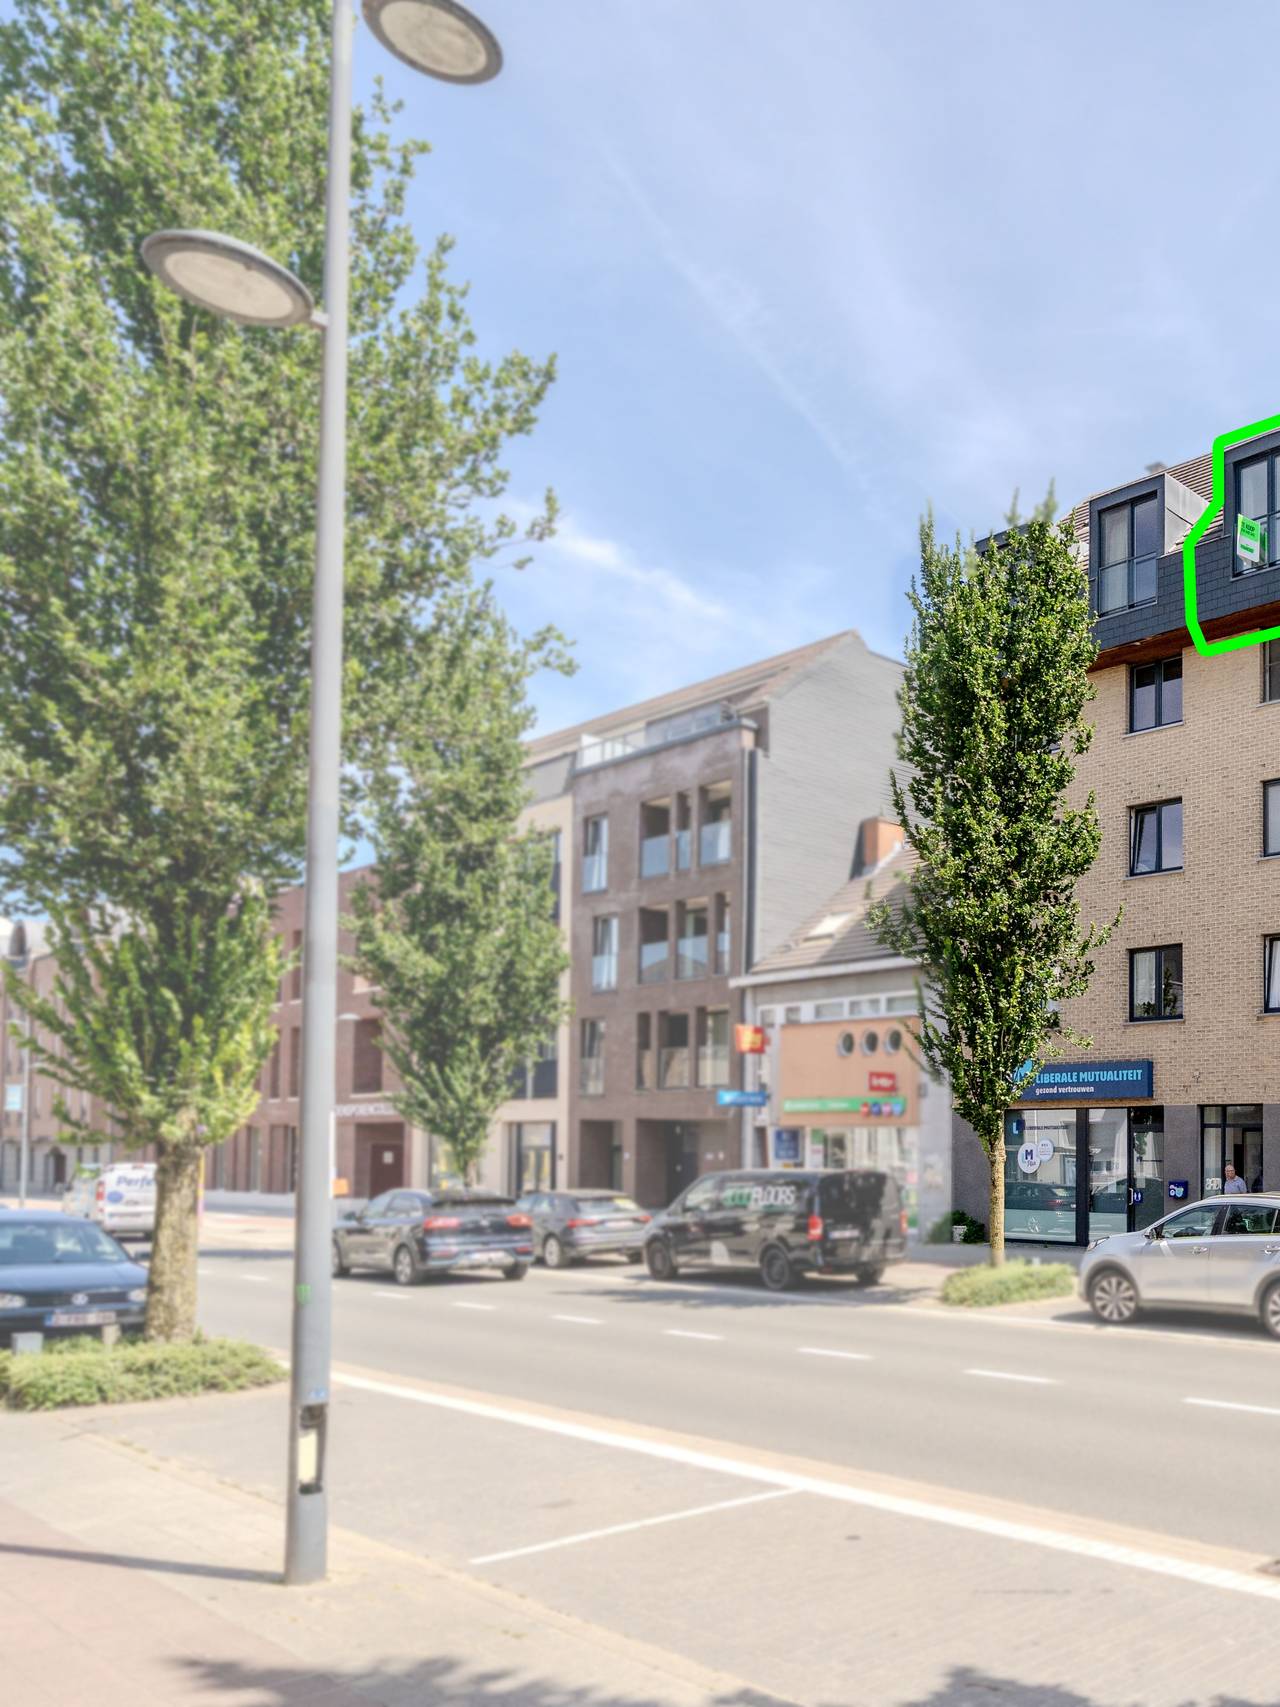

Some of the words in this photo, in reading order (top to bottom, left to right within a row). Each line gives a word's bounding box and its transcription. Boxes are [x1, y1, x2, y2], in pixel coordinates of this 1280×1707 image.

[1036, 1072, 1078, 1083] LIBERALE
[1079, 1069, 1143, 1082] MUTUALITEIT
[1035, 1087, 1058, 1095] gezond
